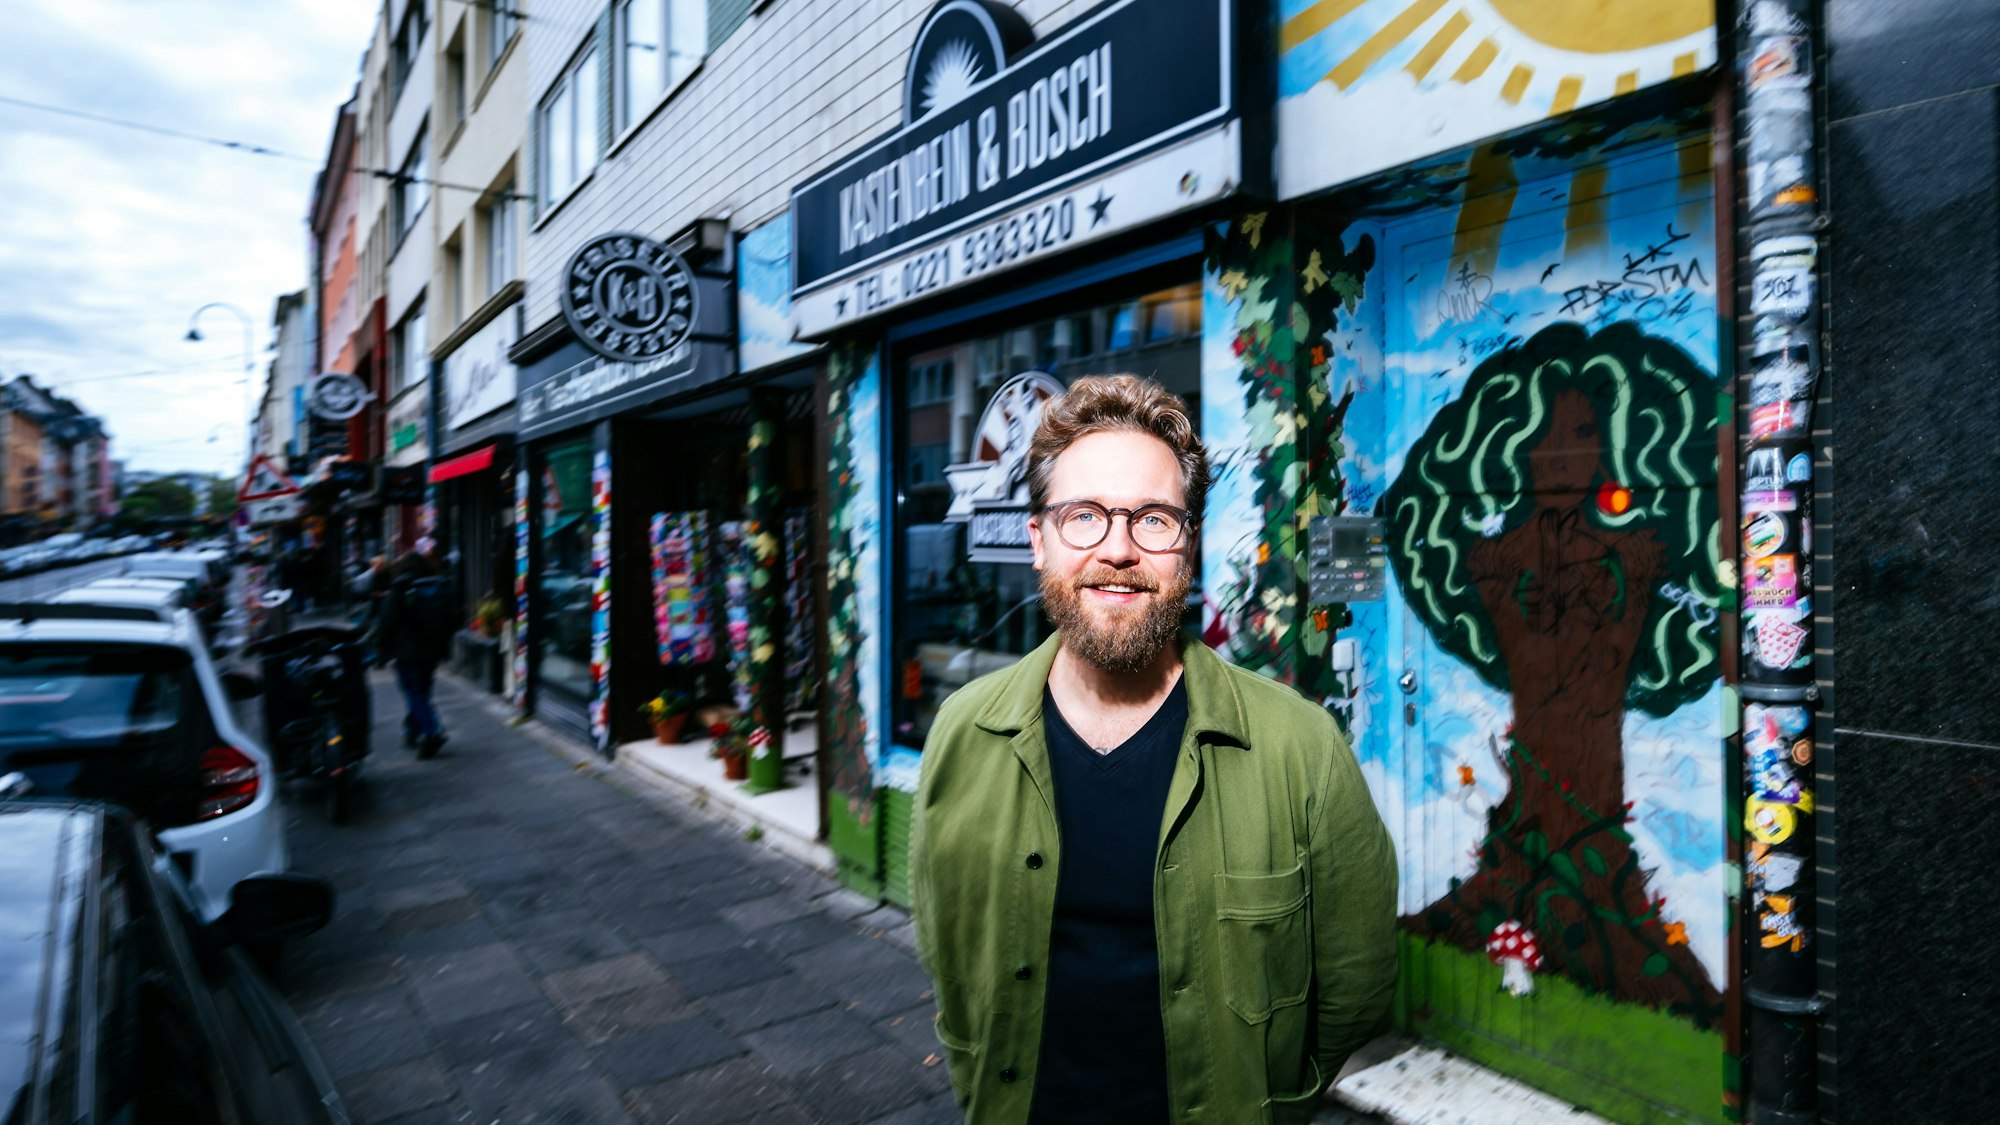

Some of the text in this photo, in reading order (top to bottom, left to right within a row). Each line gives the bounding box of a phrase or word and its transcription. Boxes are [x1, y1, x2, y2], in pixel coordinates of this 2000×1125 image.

[839, 41, 1111, 256] KASTENBEIN & BOSCH
[902, 245, 950, 298] 0221
